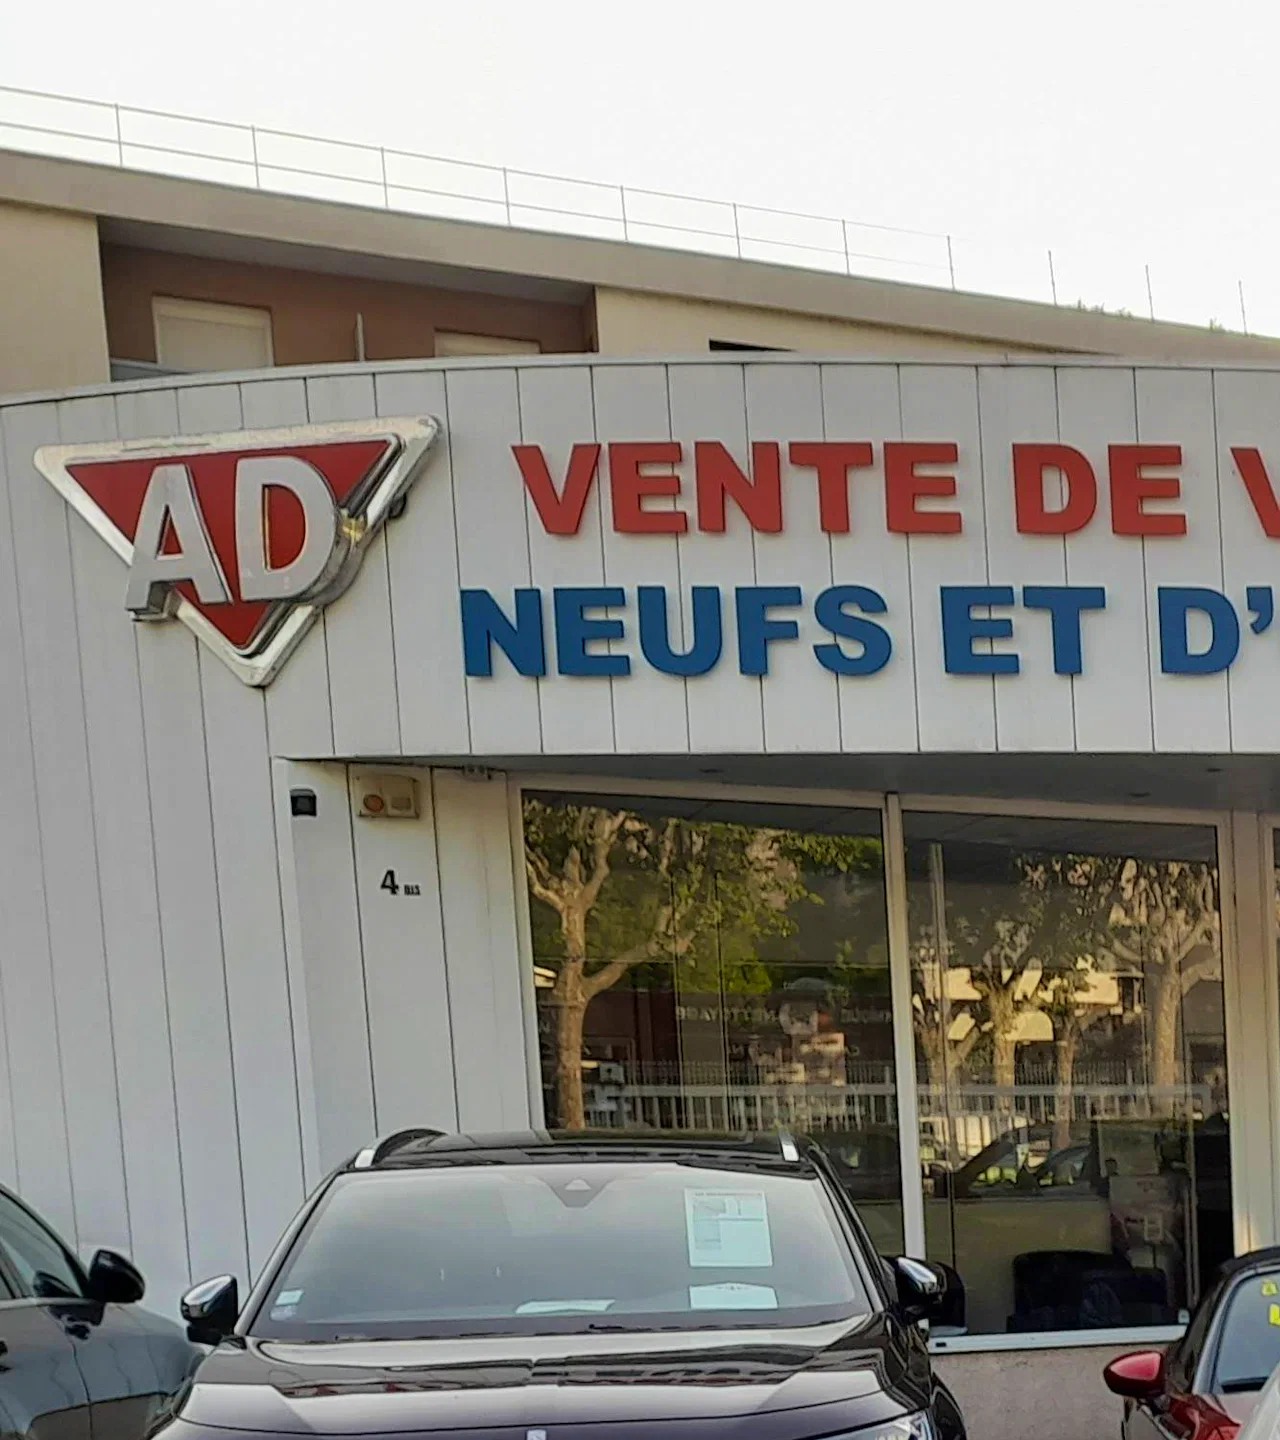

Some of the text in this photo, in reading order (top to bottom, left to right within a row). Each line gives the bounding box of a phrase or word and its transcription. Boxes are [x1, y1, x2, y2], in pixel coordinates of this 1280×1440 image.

[125, 455, 338, 609] AD
[511, 440, 963, 536] VENTE
[1011, 443, 1188, 535] DE
[460, 584, 892, 677] NEUFS
[940, 585, 1106, 675] ET
[381, 869, 399, 895] 4
